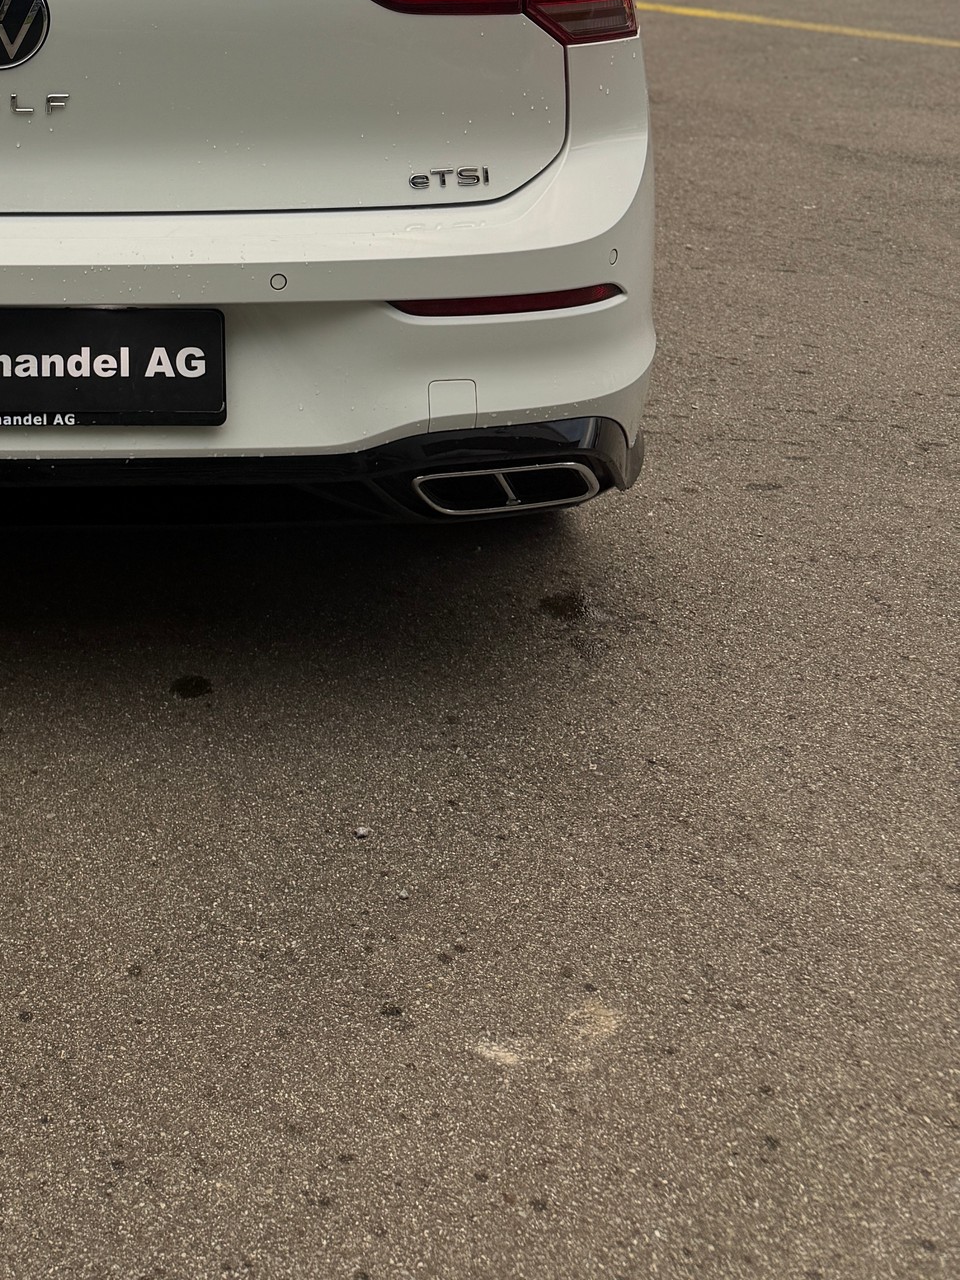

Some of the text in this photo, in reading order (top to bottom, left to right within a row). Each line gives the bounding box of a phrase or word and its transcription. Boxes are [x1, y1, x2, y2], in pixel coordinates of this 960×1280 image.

[409, 165, 489, 189] eTSI
[144, 347, 207, 378] AG
[53, 413, 76, 426] AG
